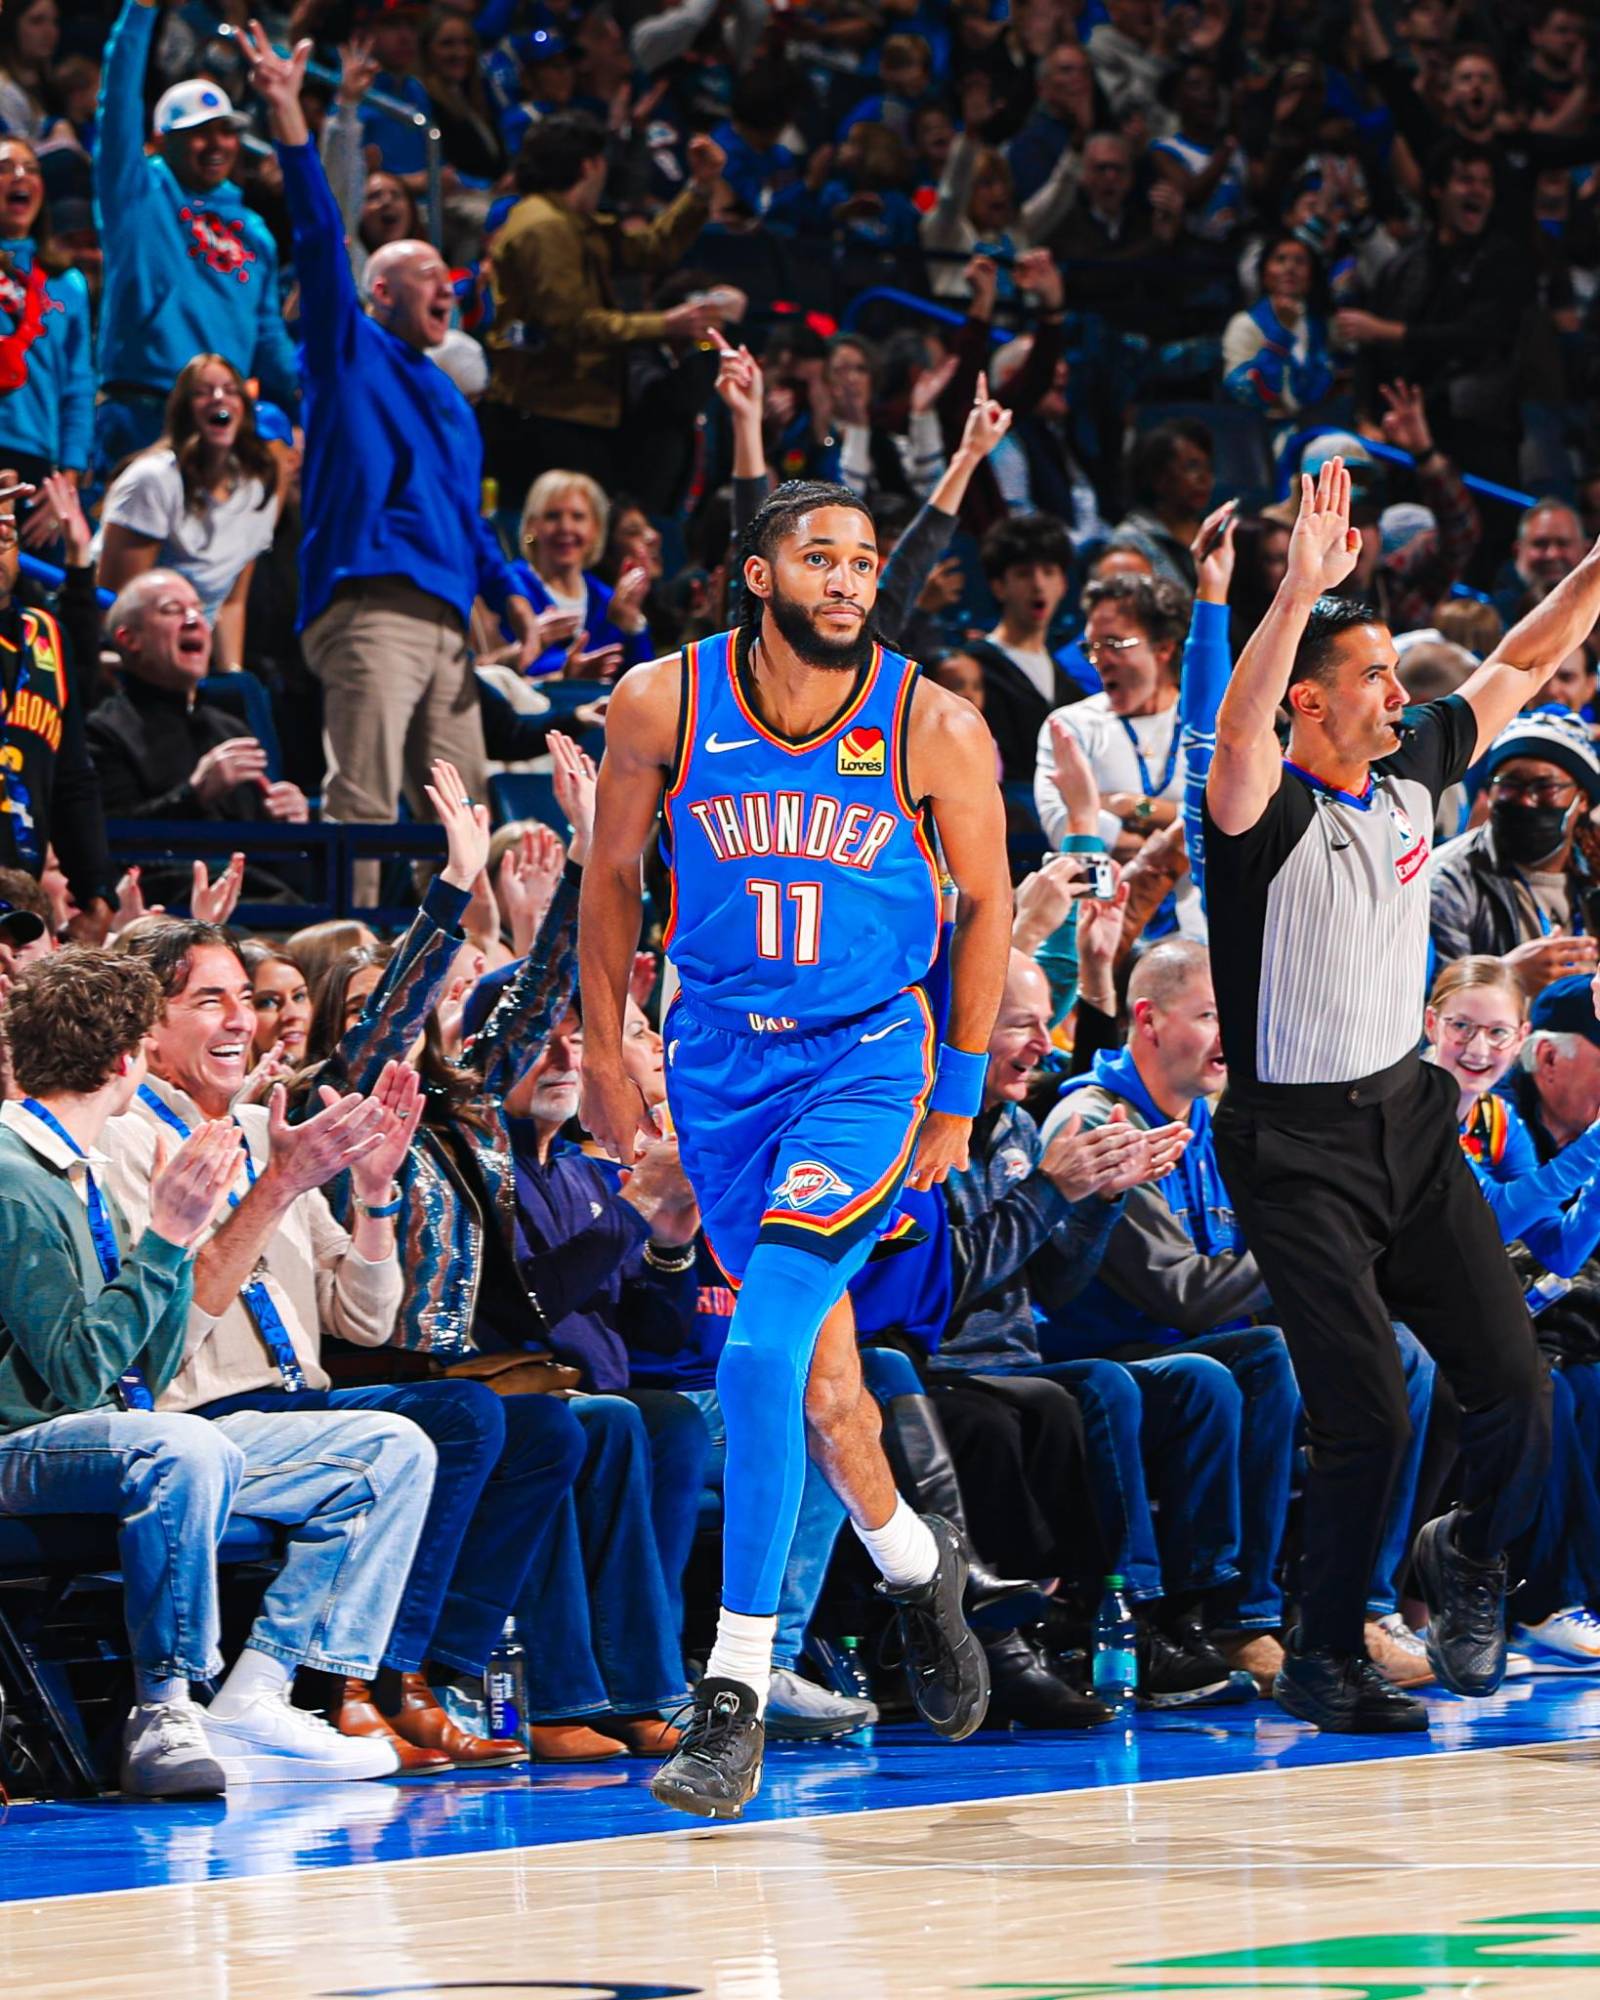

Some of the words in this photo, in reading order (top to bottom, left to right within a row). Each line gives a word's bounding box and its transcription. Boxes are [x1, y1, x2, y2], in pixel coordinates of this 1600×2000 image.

[688, 791, 898, 871] THUNDER
[746, 878, 822, 966] 11
[491, 1672, 505, 1730] smart
